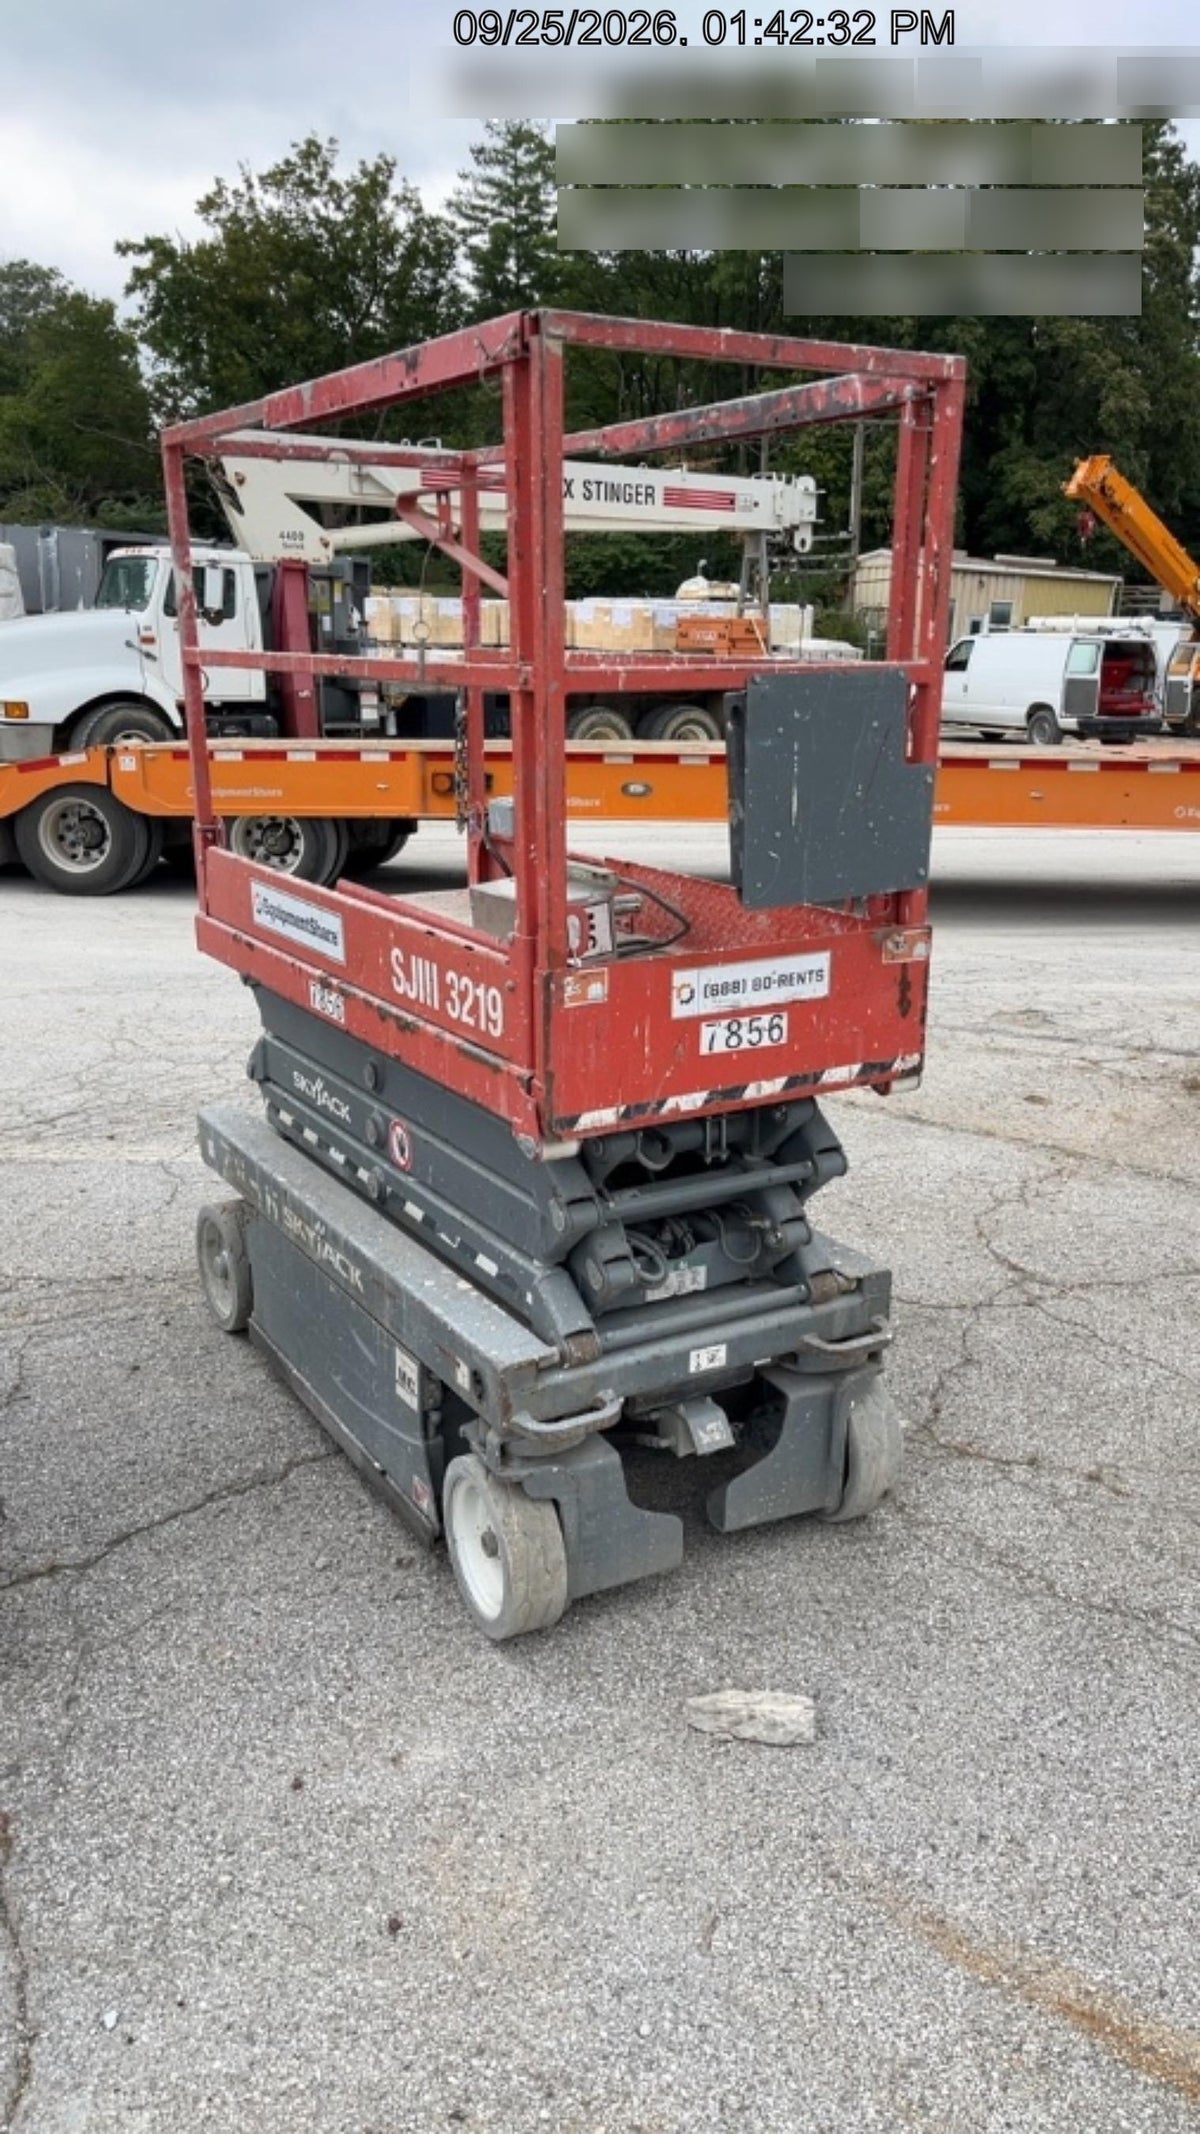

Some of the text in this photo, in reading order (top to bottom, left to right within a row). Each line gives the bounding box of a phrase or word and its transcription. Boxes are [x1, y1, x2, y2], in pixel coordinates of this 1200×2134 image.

[583, 479, 656, 506] STINGER
[391, 947, 504, 1038] SJIII 3219
[703, 968, 824, 999] (888) 80-RENTS
[705, 1014, 784, 1052] 7856
[293, 1070, 352, 1125] SKYJACK
